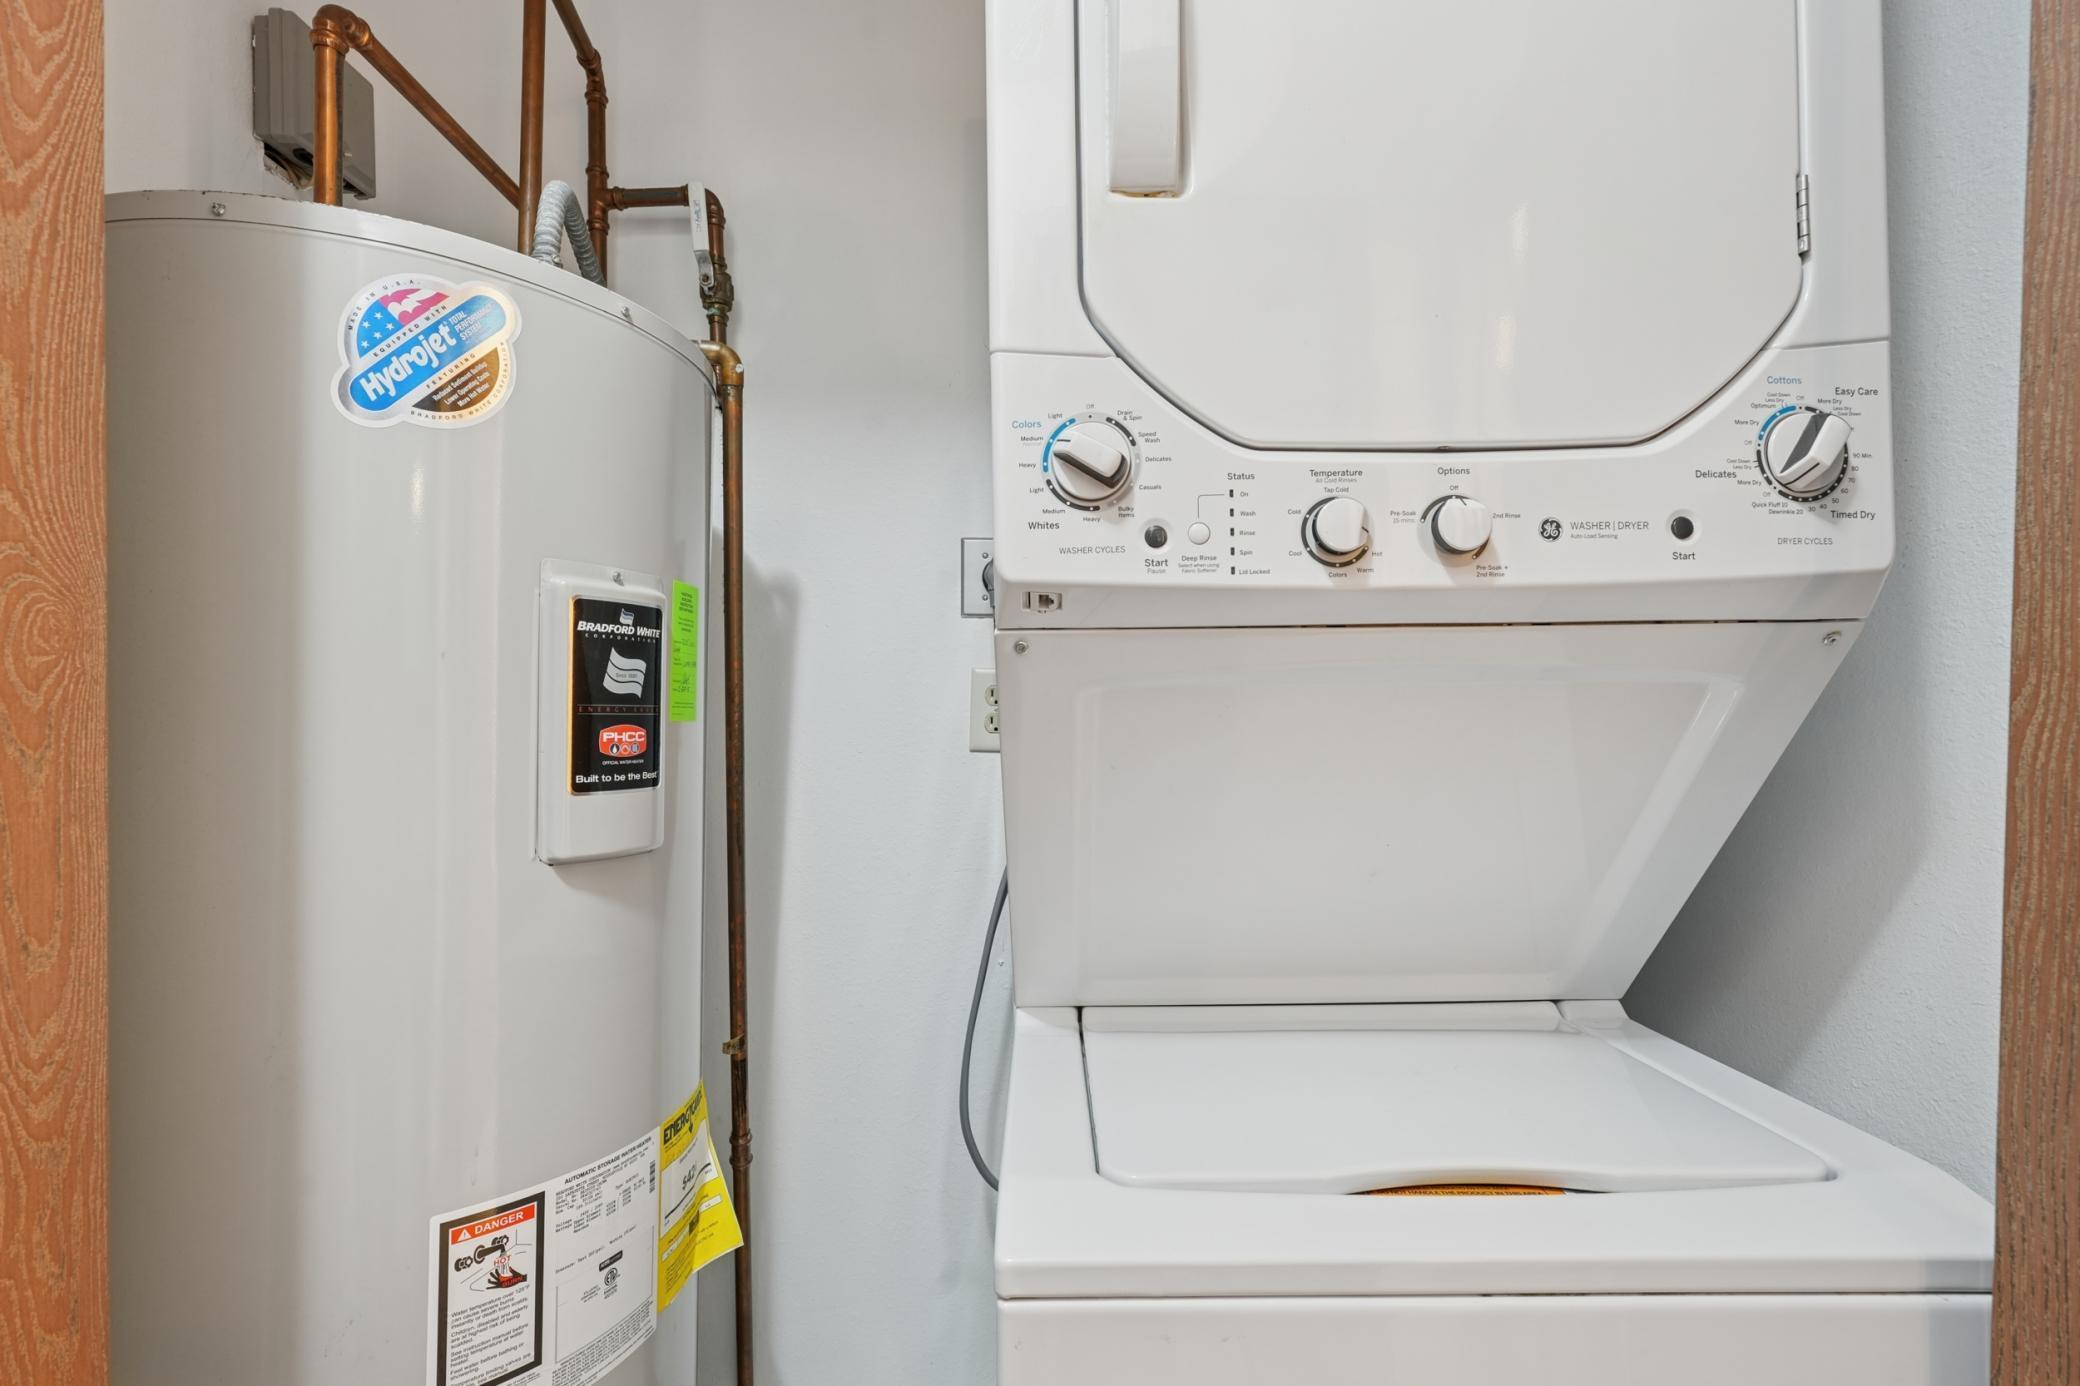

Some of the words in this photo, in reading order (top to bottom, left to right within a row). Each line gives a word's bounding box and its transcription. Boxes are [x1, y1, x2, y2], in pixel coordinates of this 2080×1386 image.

[373, 323, 420, 358] EQUIPPED
[424, 305, 447, 322] WITH
[359, 323, 457, 401] Hydrojet
[426, 353, 476, 389] FEATURING
[1767, 376, 1802, 385] Cottons
[1835, 387, 1856, 397] Easy
[1858, 388, 1879, 396] Care
[1048, 412, 1063, 420] Light
[1011, 420, 1042, 429] Colors
[1310, 469, 1363, 480] Temperature
[1437, 467, 1470, 476] Options
[1695, 470, 1737, 479] Delicates
[1227, 473, 1255, 481] Status
[1830, 511, 1858, 519] Timed
[1860, 511, 1876, 520] Dry
[1028, 521, 1060, 530] Whites
[1570, 521, 1611, 530] WASHER
[1618, 521, 1649, 530] DRYER
[1804, 537, 1833, 545] CYCLES
[1058, 547, 1093, 555] WASHER
[1095, 546, 1126, 554] CYCLES
[1672, 551, 1696, 560] Start
[1144, 559, 1168, 567] Start
[577, 620, 635, 636] BRADFORD
[637, 626, 661, 638] WHITE
[603, 731, 646, 742] PHCC
[576, 774, 599, 784] Built
[601, 774, 612, 782] to
[614, 773, 626, 781] be
[628, 772, 641, 781] the
[642, 771, 658, 780] Best
[565, 1166, 597, 1184] AUTOMATIC
[597, 1154, 621, 1170] STORAGE
[474, 1211, 524, 1235] DANGER
[493, 1255, 511, 1267] HOT
